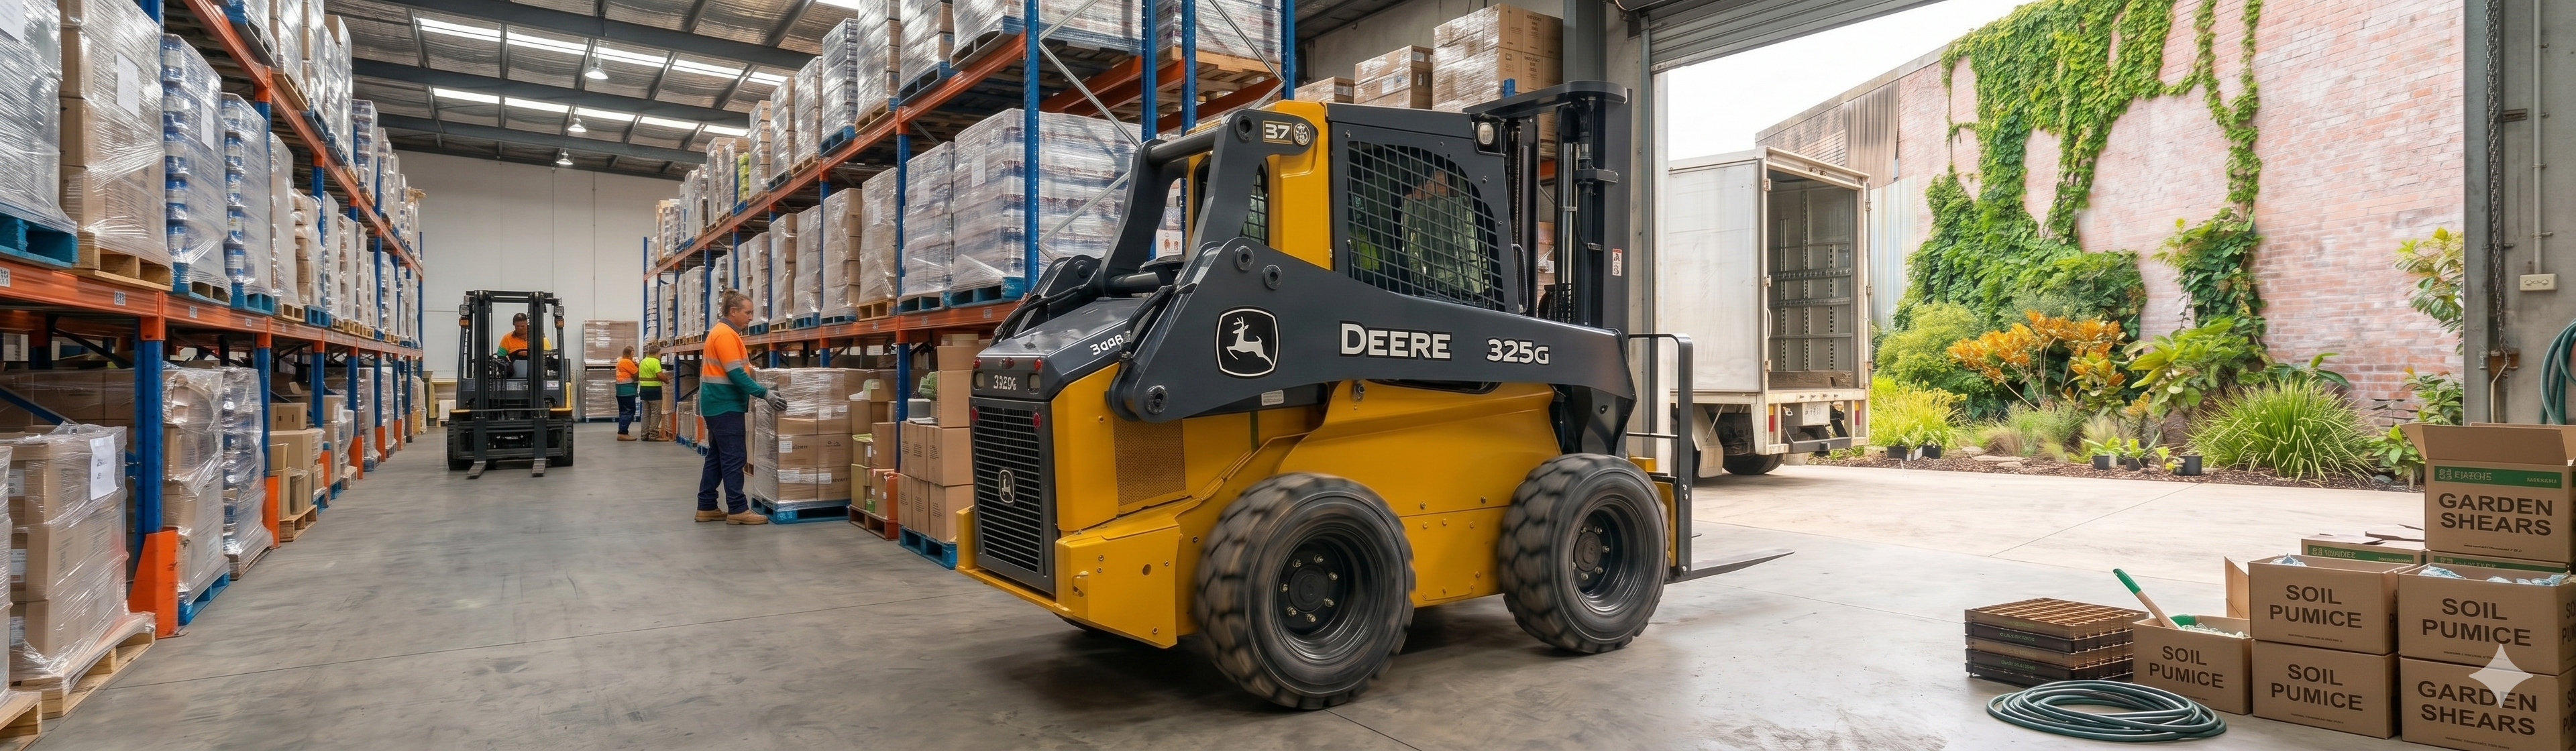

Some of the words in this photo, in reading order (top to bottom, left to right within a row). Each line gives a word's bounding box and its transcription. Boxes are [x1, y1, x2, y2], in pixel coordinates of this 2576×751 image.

[1265, 123, 1290, 139] 37
[1341, 323, 1451, 359] DEERE
[1487, 339, 1550, 364] 325G
[2438, 493, 2553, 516] GARDEN
[2440, 512, 2551, 536] SHEARS
[2286, 584, 2342, 605] SOIL
[2269, 604, 2362, 628] PUMICE
[2441, 598, 2508, 620] SOIL
[2422, 619, 2532, 647] PUMICE
[2162, 645, 2207, 666] SOIL
[2149, 662, 2224, 689] PUMICE
[2288, 664, 2343, 686] SOIL
[2271, 683, 2363, 711] PUMICE
[2417, 681, 2537, 712] GARDEN
[2421, 704, 2536, 736] SHEARS
